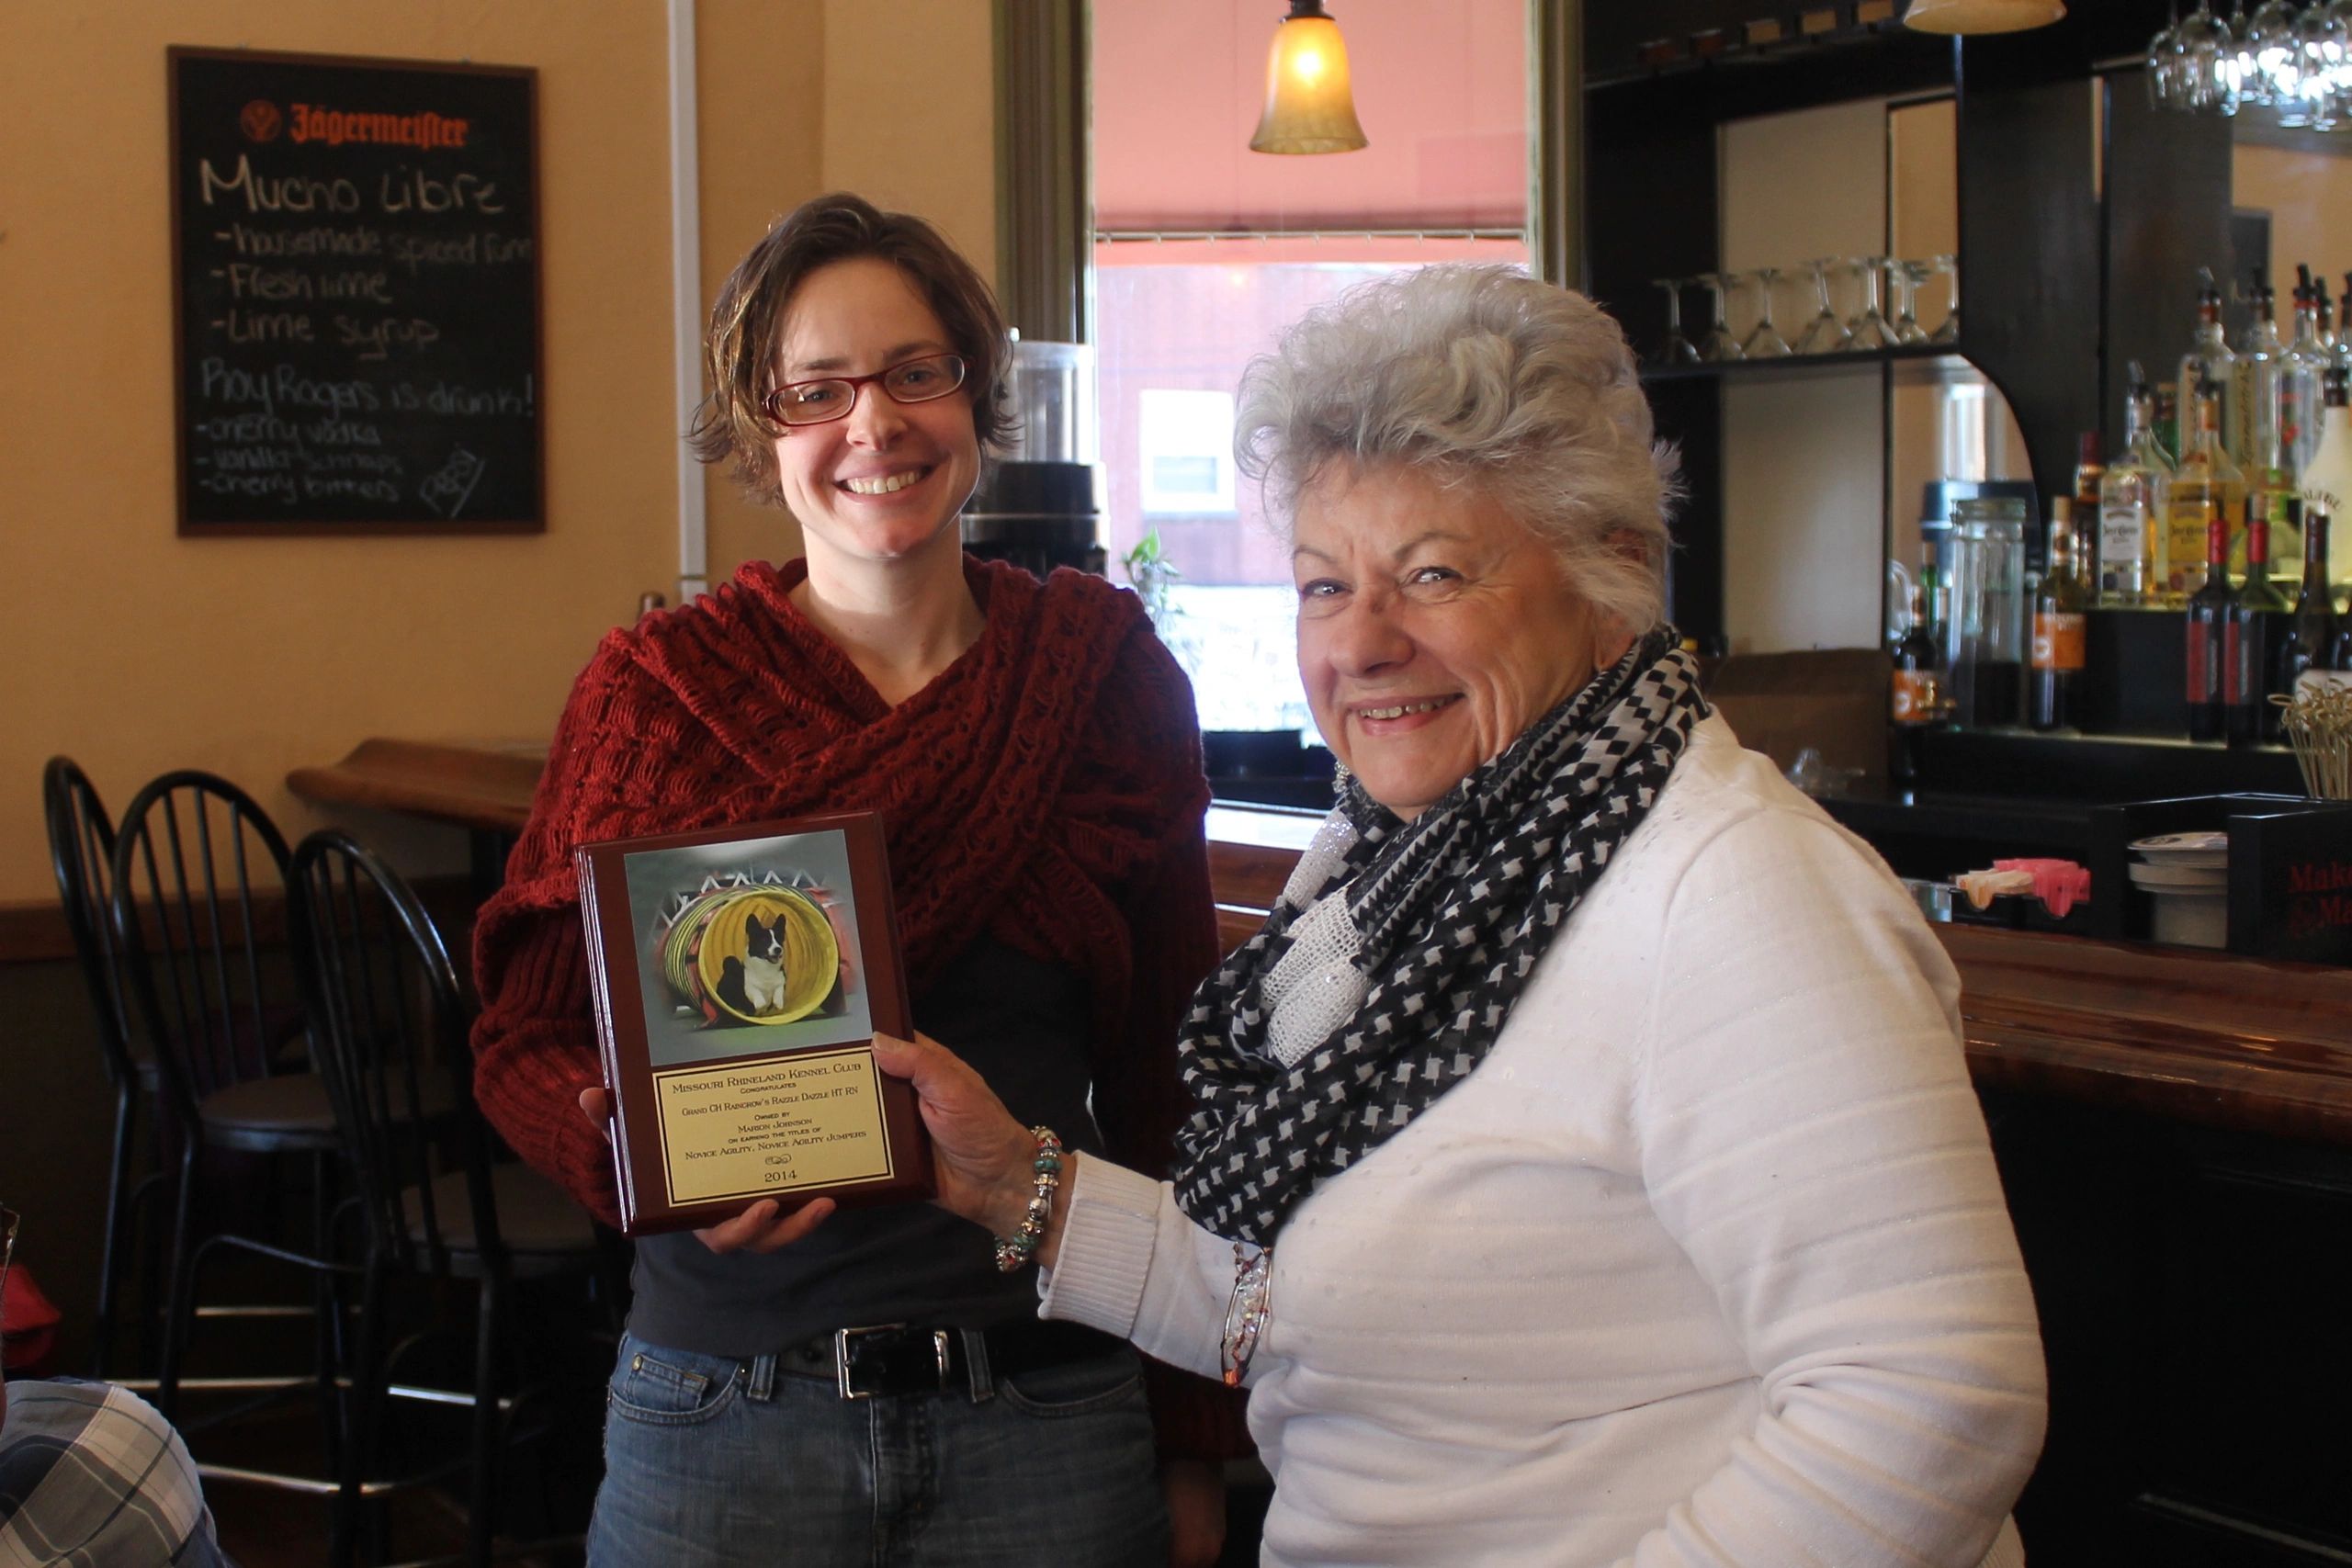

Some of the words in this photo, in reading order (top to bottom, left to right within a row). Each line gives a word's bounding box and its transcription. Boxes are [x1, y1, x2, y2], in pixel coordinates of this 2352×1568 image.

[290, 103, 469, 149] Jägermeister
[198, 152, 360, 214] Mucho
[380, 164, 506, 215] Libre
[390, 380, 420, 411] is
[673, 1080, 724, 1094] MISSOURI
[727, 1073, 786, 1088] RHINELAND
[788, 1067, 831, 1079] KENNEL
[832, 1063, 862, 1074] CLUB
[709, 1103, 722, 1113] CH
[764, 1169, 797, 1183] 2014
